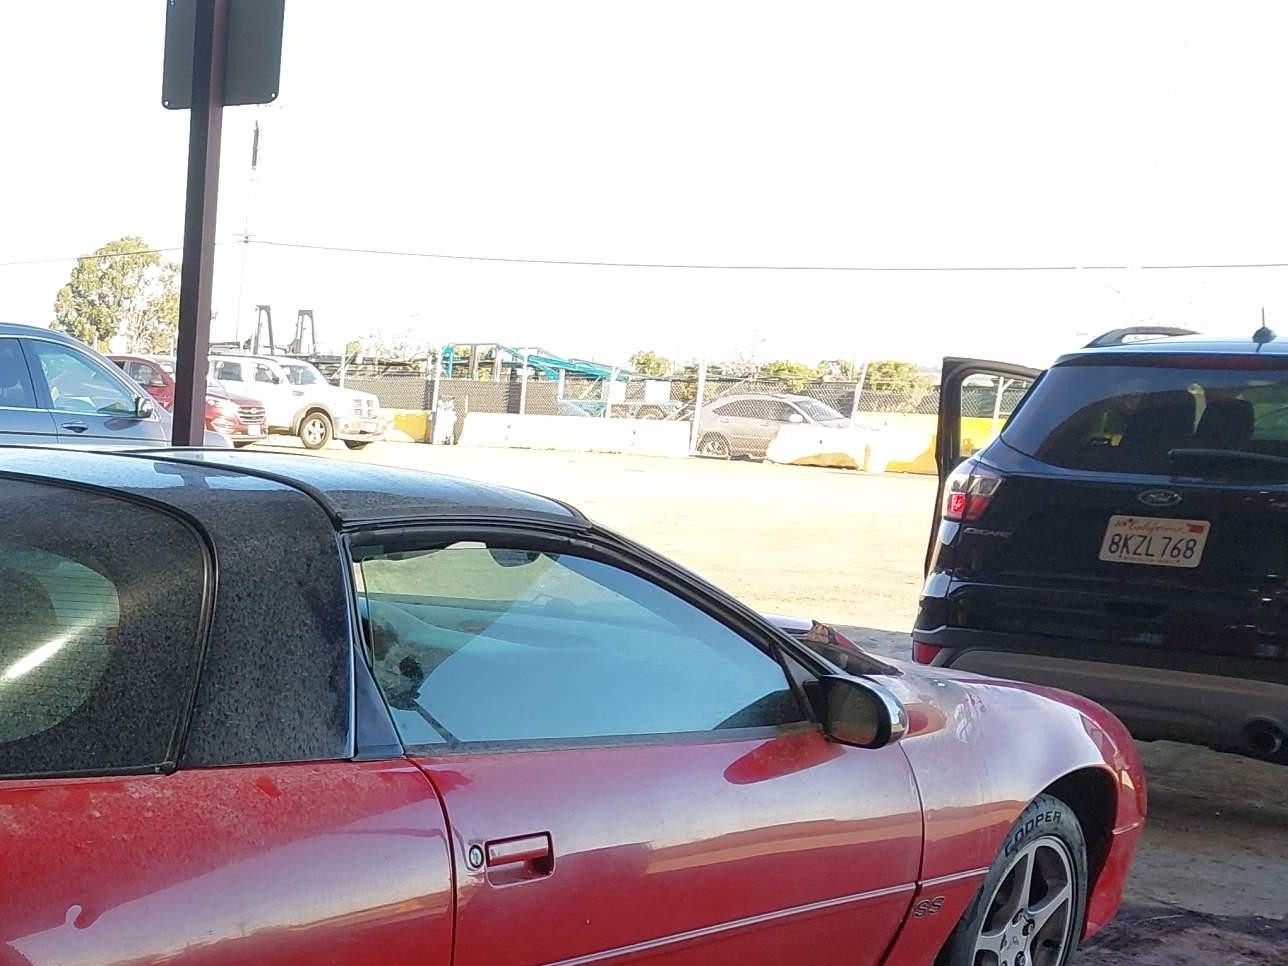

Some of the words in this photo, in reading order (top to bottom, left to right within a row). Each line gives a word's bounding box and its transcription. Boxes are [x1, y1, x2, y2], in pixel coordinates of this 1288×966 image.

[1108, 533, 1197, 560] 8KZL768
[1004, 810, 1062, 858] COOPER
[914, 895, 945, 918] SS
